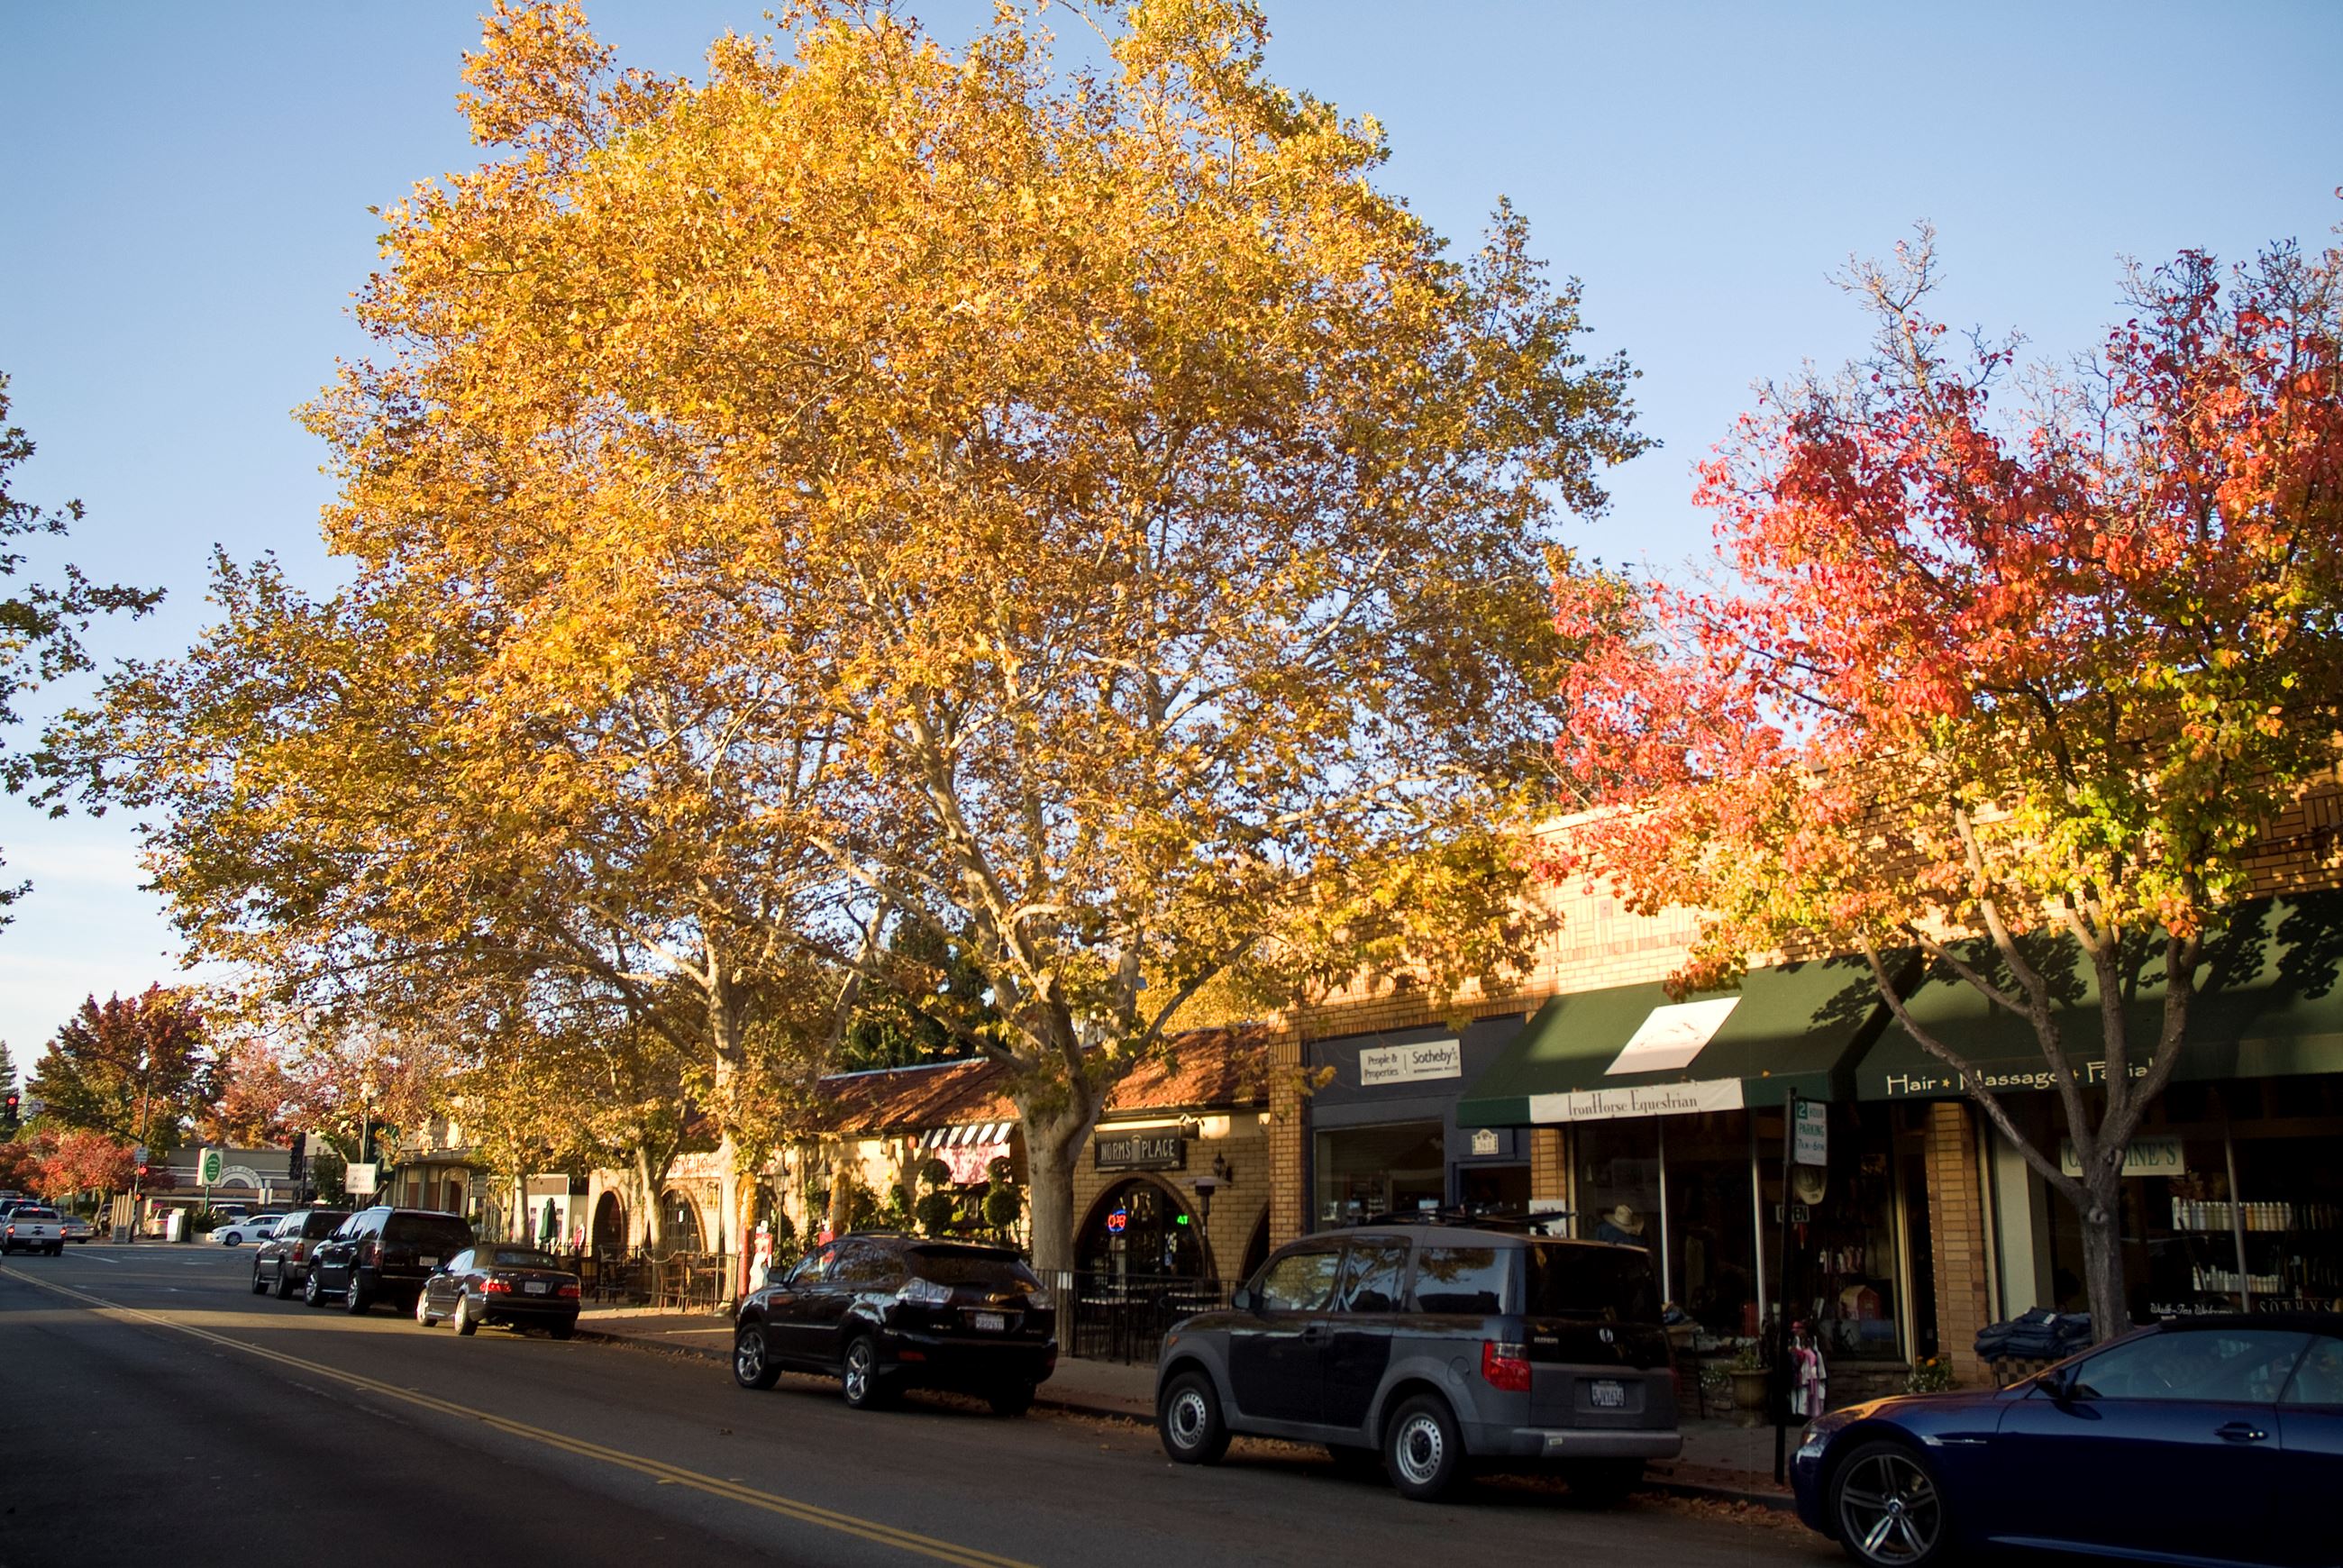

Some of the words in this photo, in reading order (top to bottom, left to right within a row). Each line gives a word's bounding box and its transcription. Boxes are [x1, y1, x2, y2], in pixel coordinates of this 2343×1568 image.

[1368, 1053, 1390, 1067] People
[1391, 1053, 1398, 1062] &
[1412, 1047, 1458, 1065] Sotheby's
[1364, 1067, 1399, 1080] Properties
[1886, 1074, 1937, 1096] Hair
[1568, 1092, 1627, 1117] IronHorse
[1630, 1089, 1698, 1113] Equestrian
[1798, 1101, 1806, 1117] 2
[1800, 1123, 1825, 1137] PARKING
[1141, 1138, 1174, 1159] PLACE
